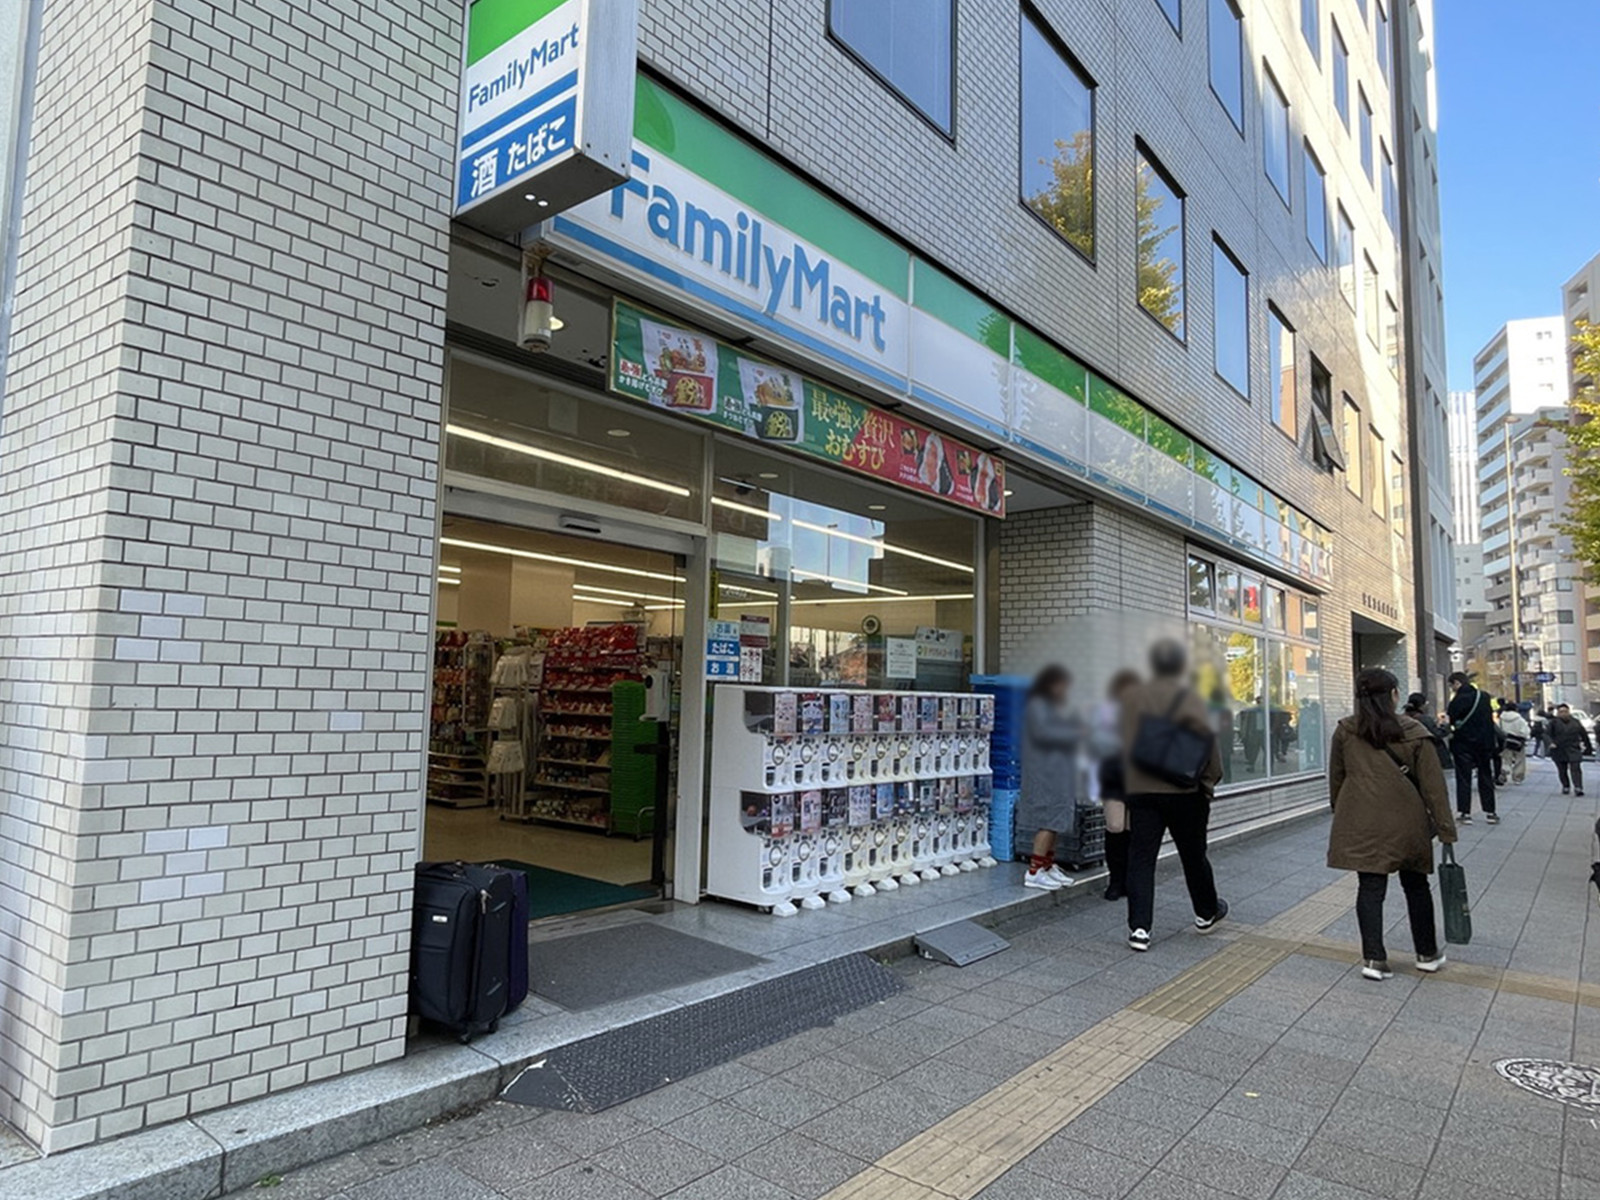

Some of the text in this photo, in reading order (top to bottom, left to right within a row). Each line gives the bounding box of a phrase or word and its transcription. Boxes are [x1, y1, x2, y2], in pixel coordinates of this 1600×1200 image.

[469, 23, 579, 113] FamilyMart
[471, 115, 566, 198] 酒 たばこ
[611, 150, 886, 353] FamilyMart
[711, 642, 735, 655] たばこ
